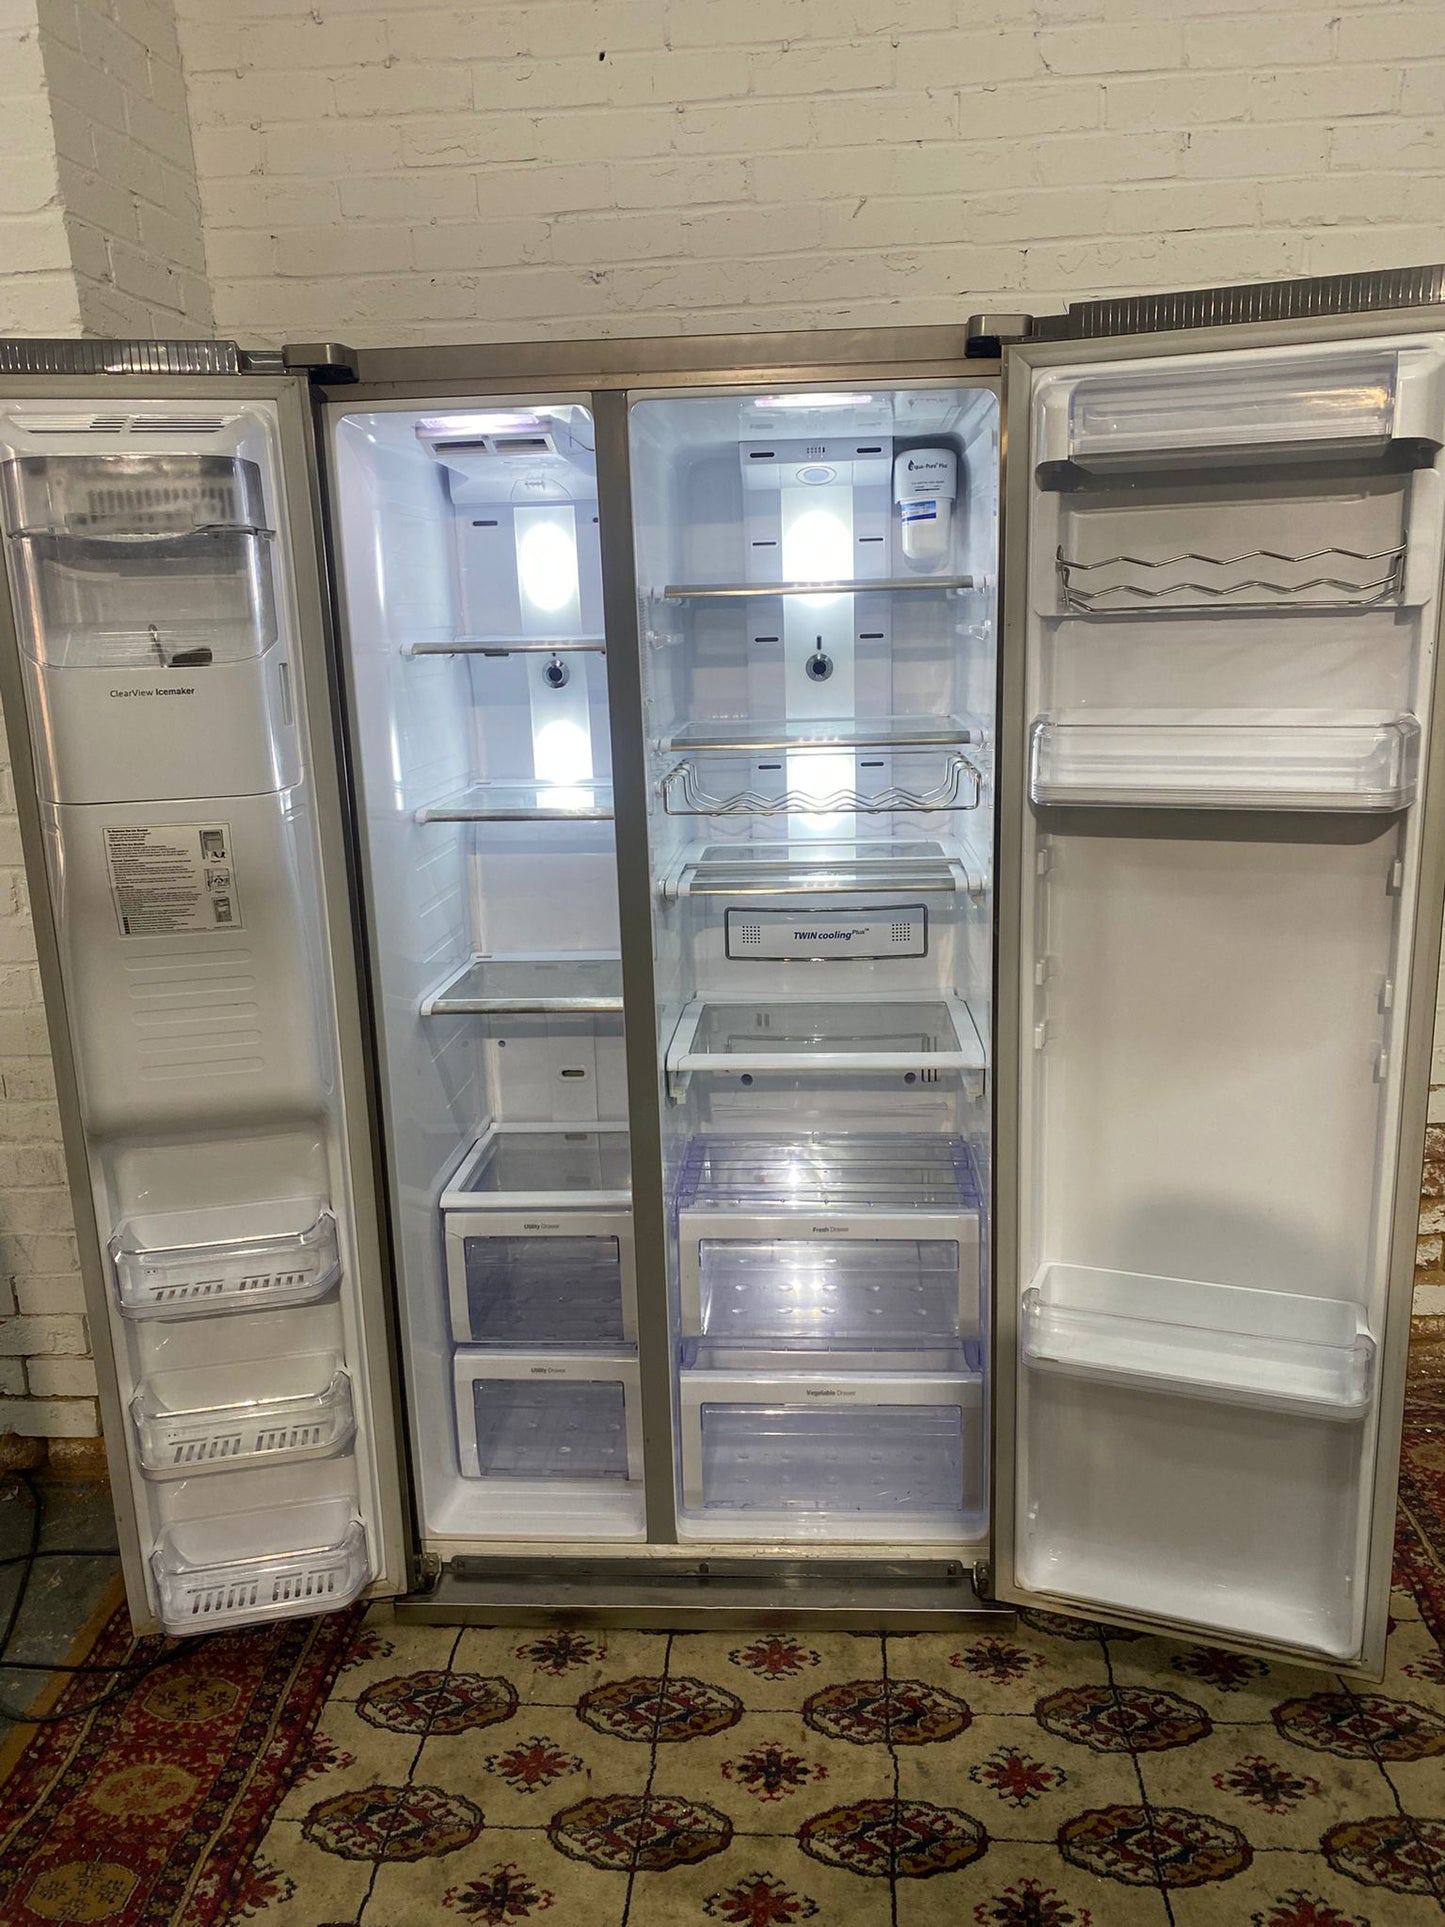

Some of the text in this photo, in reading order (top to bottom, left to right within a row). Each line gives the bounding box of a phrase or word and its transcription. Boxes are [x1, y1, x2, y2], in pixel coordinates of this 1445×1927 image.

[110, 687, 195, 698] ClearView Icemaker
[794, 931, 818, 940] TWIN
